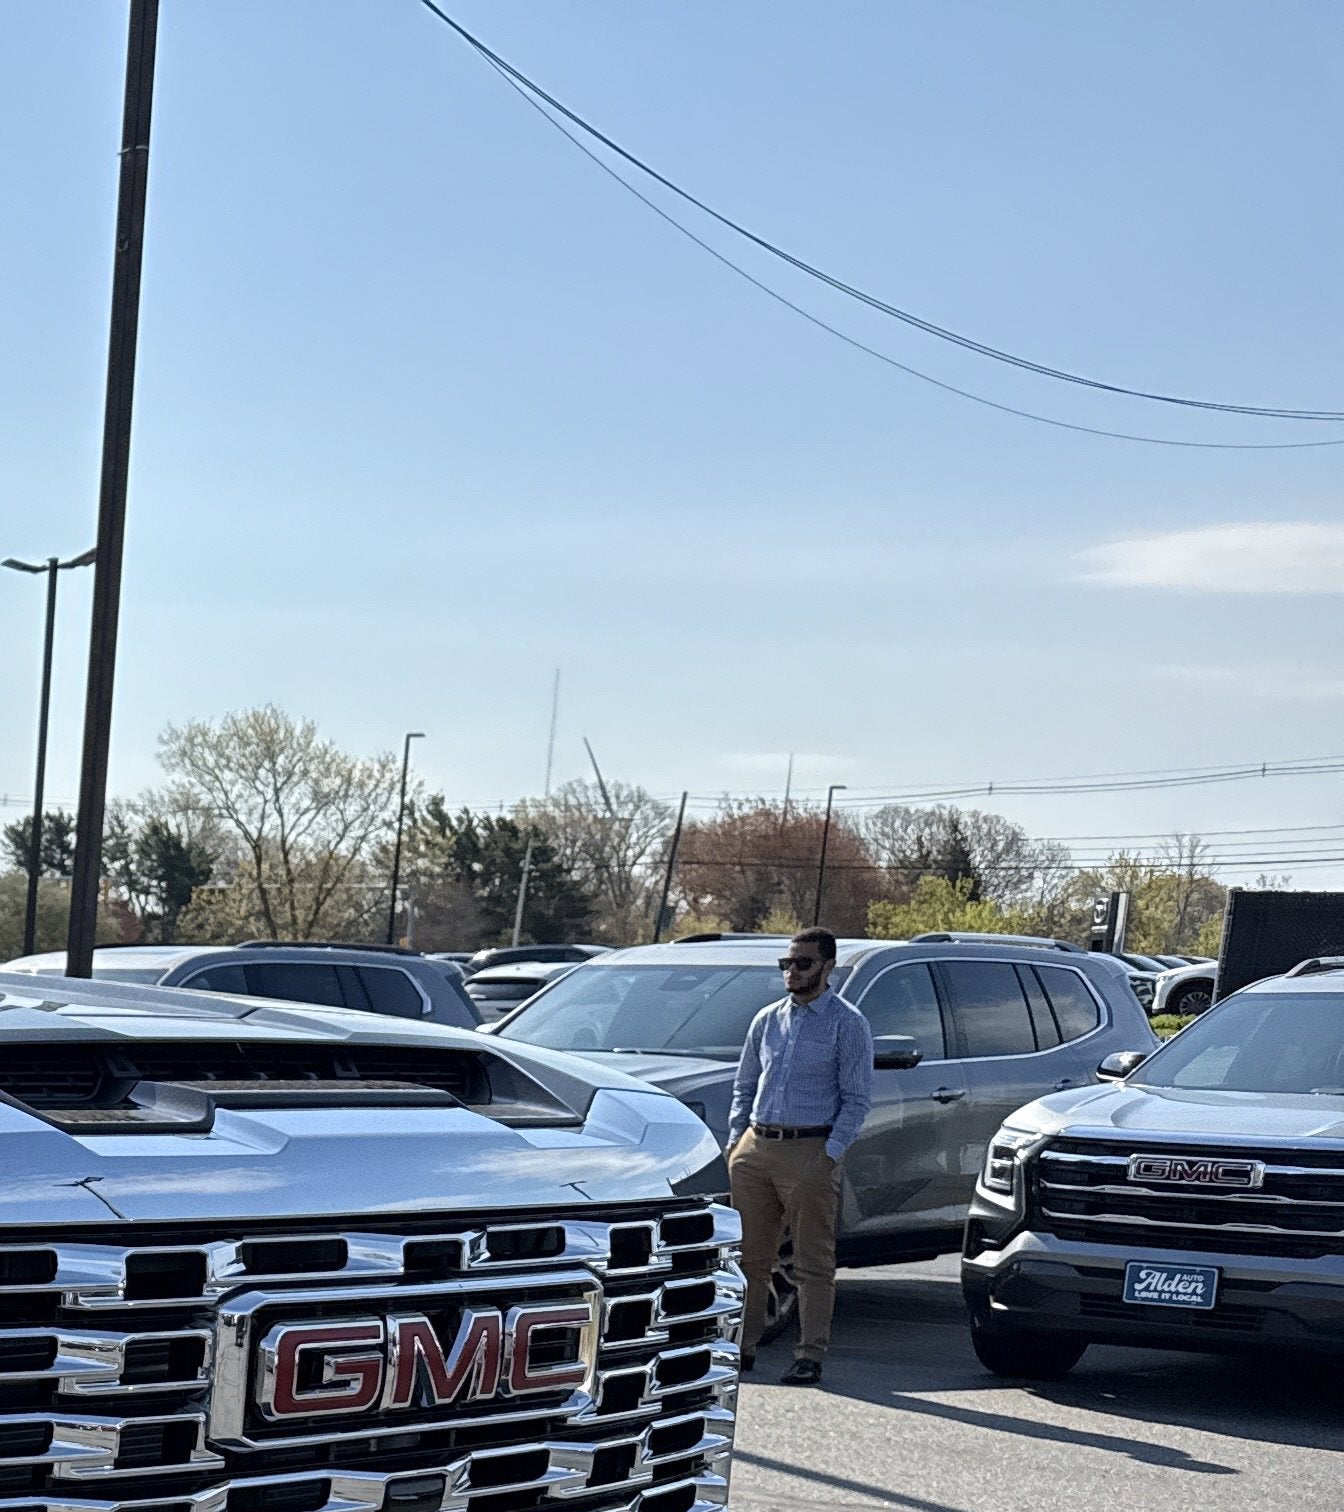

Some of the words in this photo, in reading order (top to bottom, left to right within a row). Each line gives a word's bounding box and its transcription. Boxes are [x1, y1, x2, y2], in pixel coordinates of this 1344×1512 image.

[1135, 1158, 1252, 1185] GMC
[1134, 1269, 1207, 1295] Alden
[1181, 1274, 1204, 1282] AUTO
[1134, 1290, 1159, 1299] LOVE
[1172, 1293, 1204, 1303] LOCAL
[255, 1300, 593, 1422] GMC
